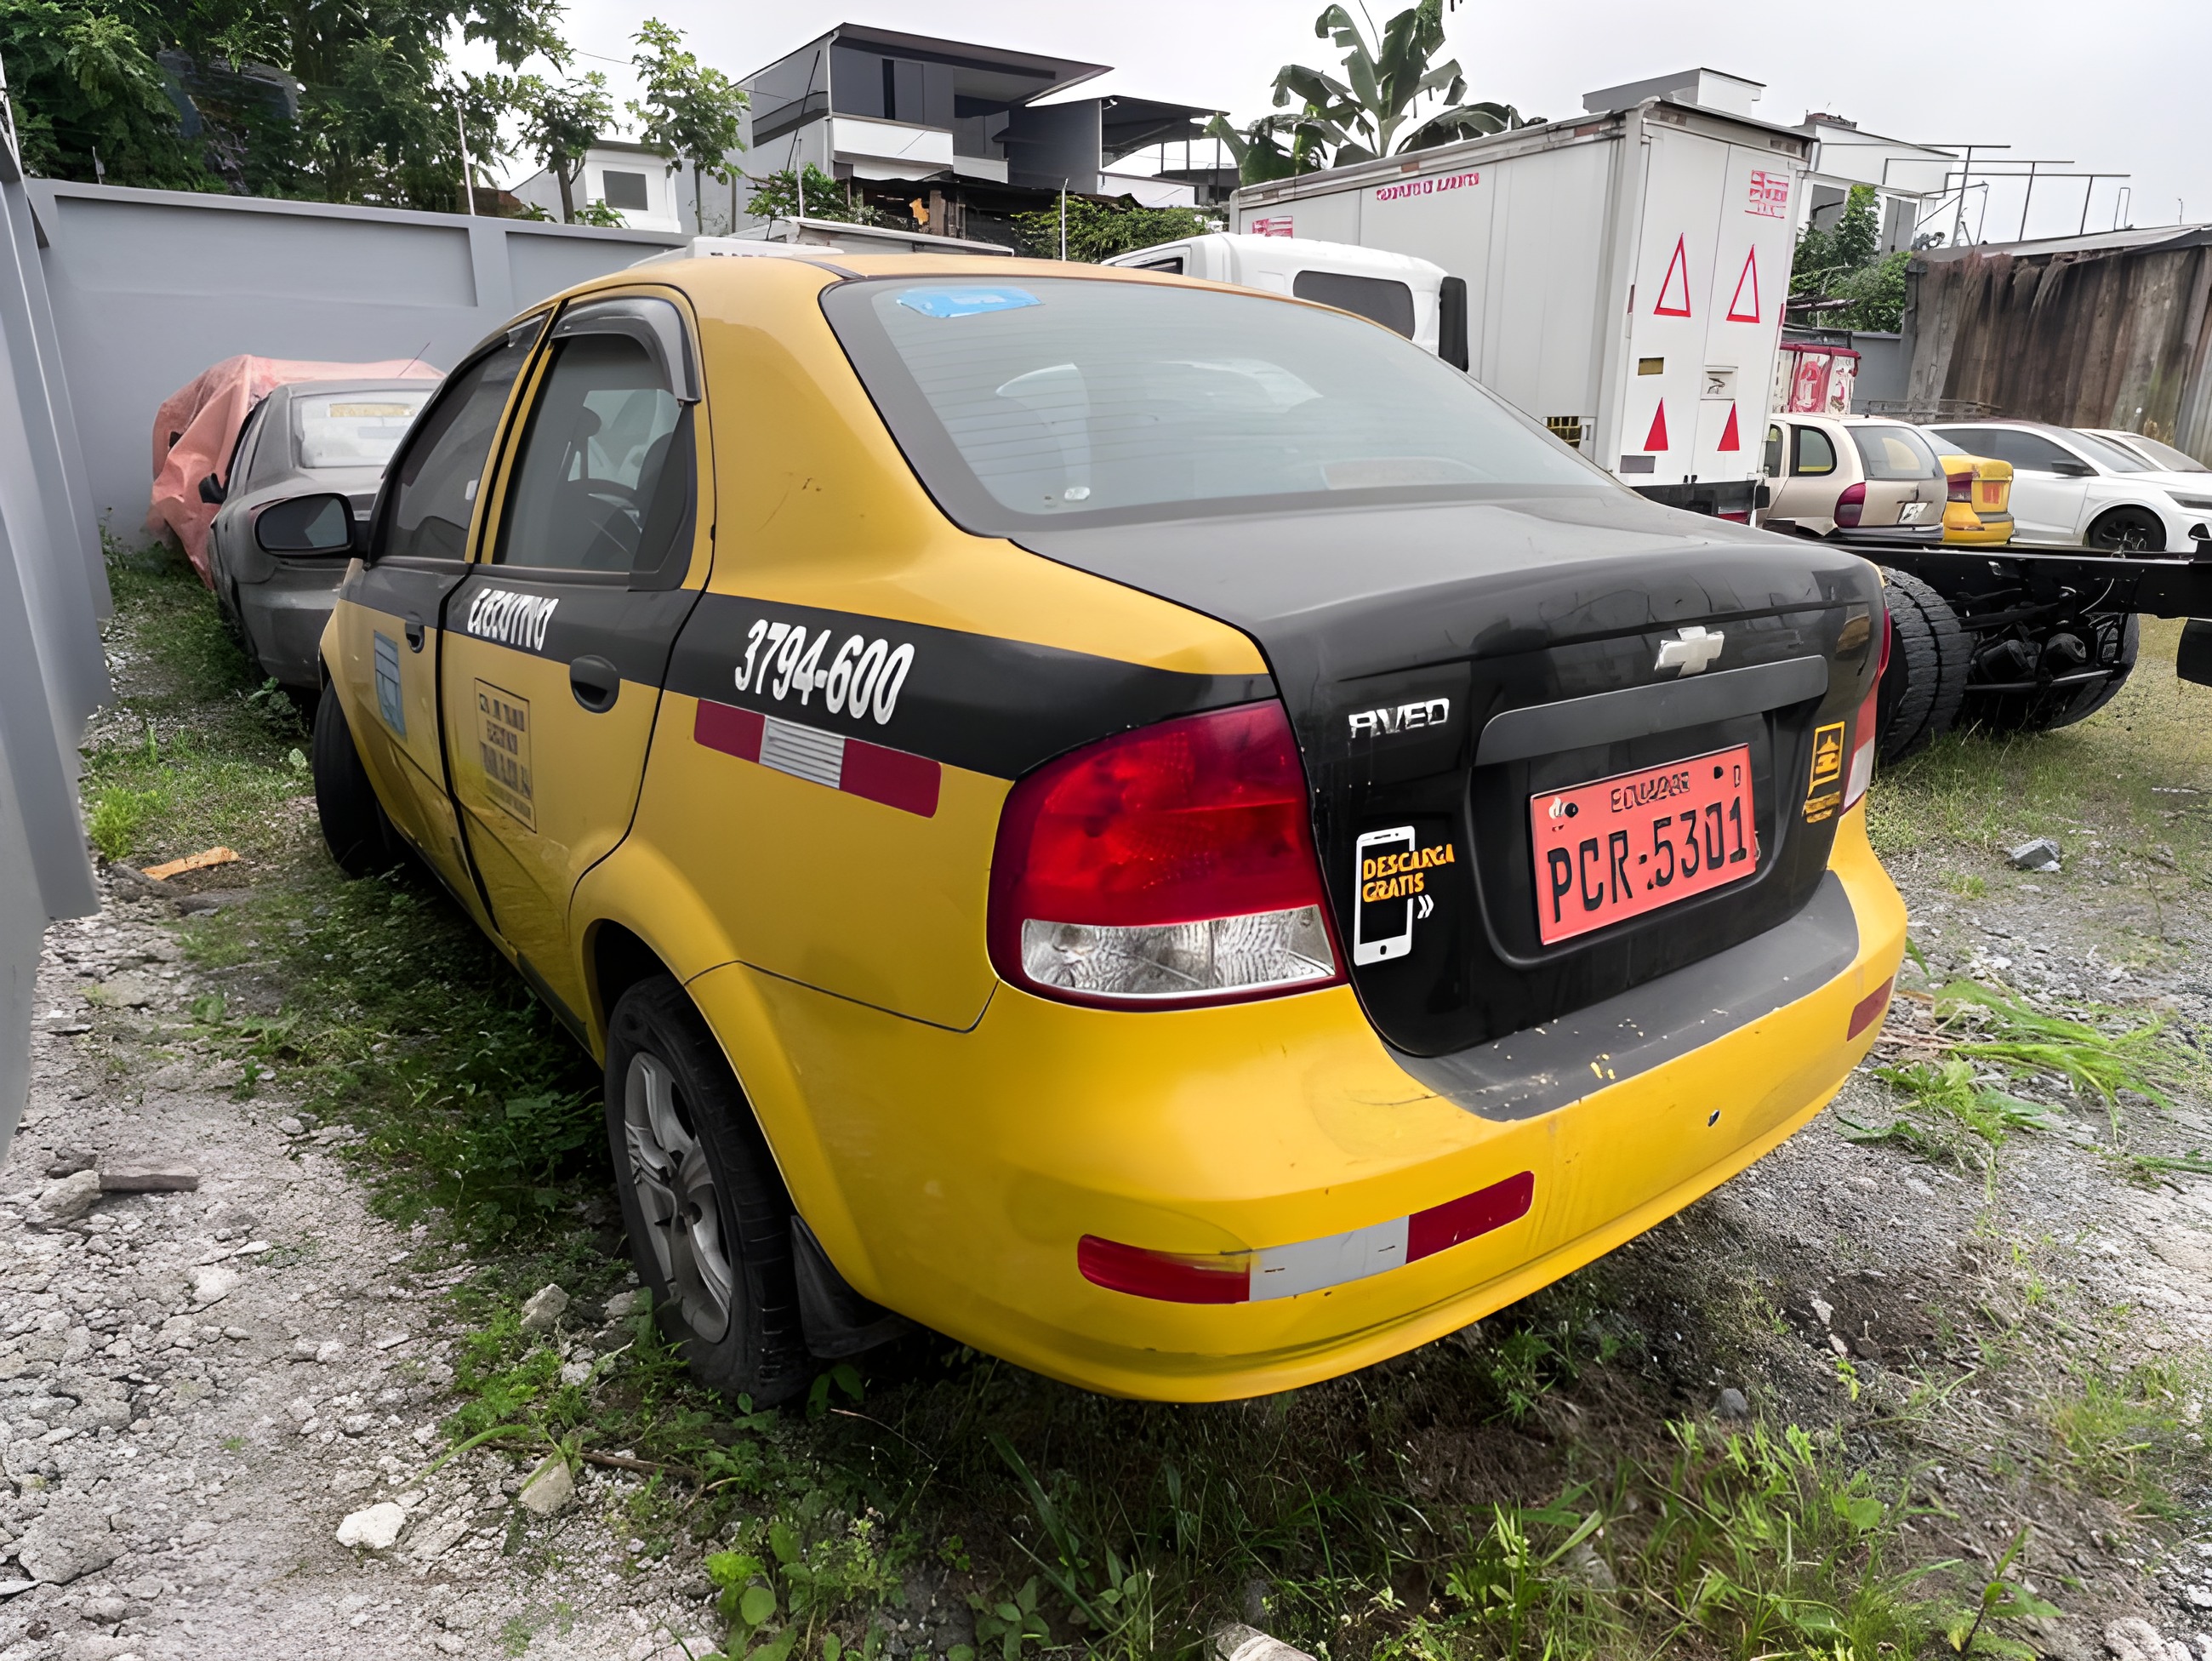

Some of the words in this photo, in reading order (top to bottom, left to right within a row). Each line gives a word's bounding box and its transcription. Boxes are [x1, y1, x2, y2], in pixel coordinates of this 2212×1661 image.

[735, 619, 915, 725] 3794-600
[1348, 698, 1450, 739] AVEO
[1363, 843, 1456, 882] DESCARGA
[1362, 872, 1425, 903] GRATIS
